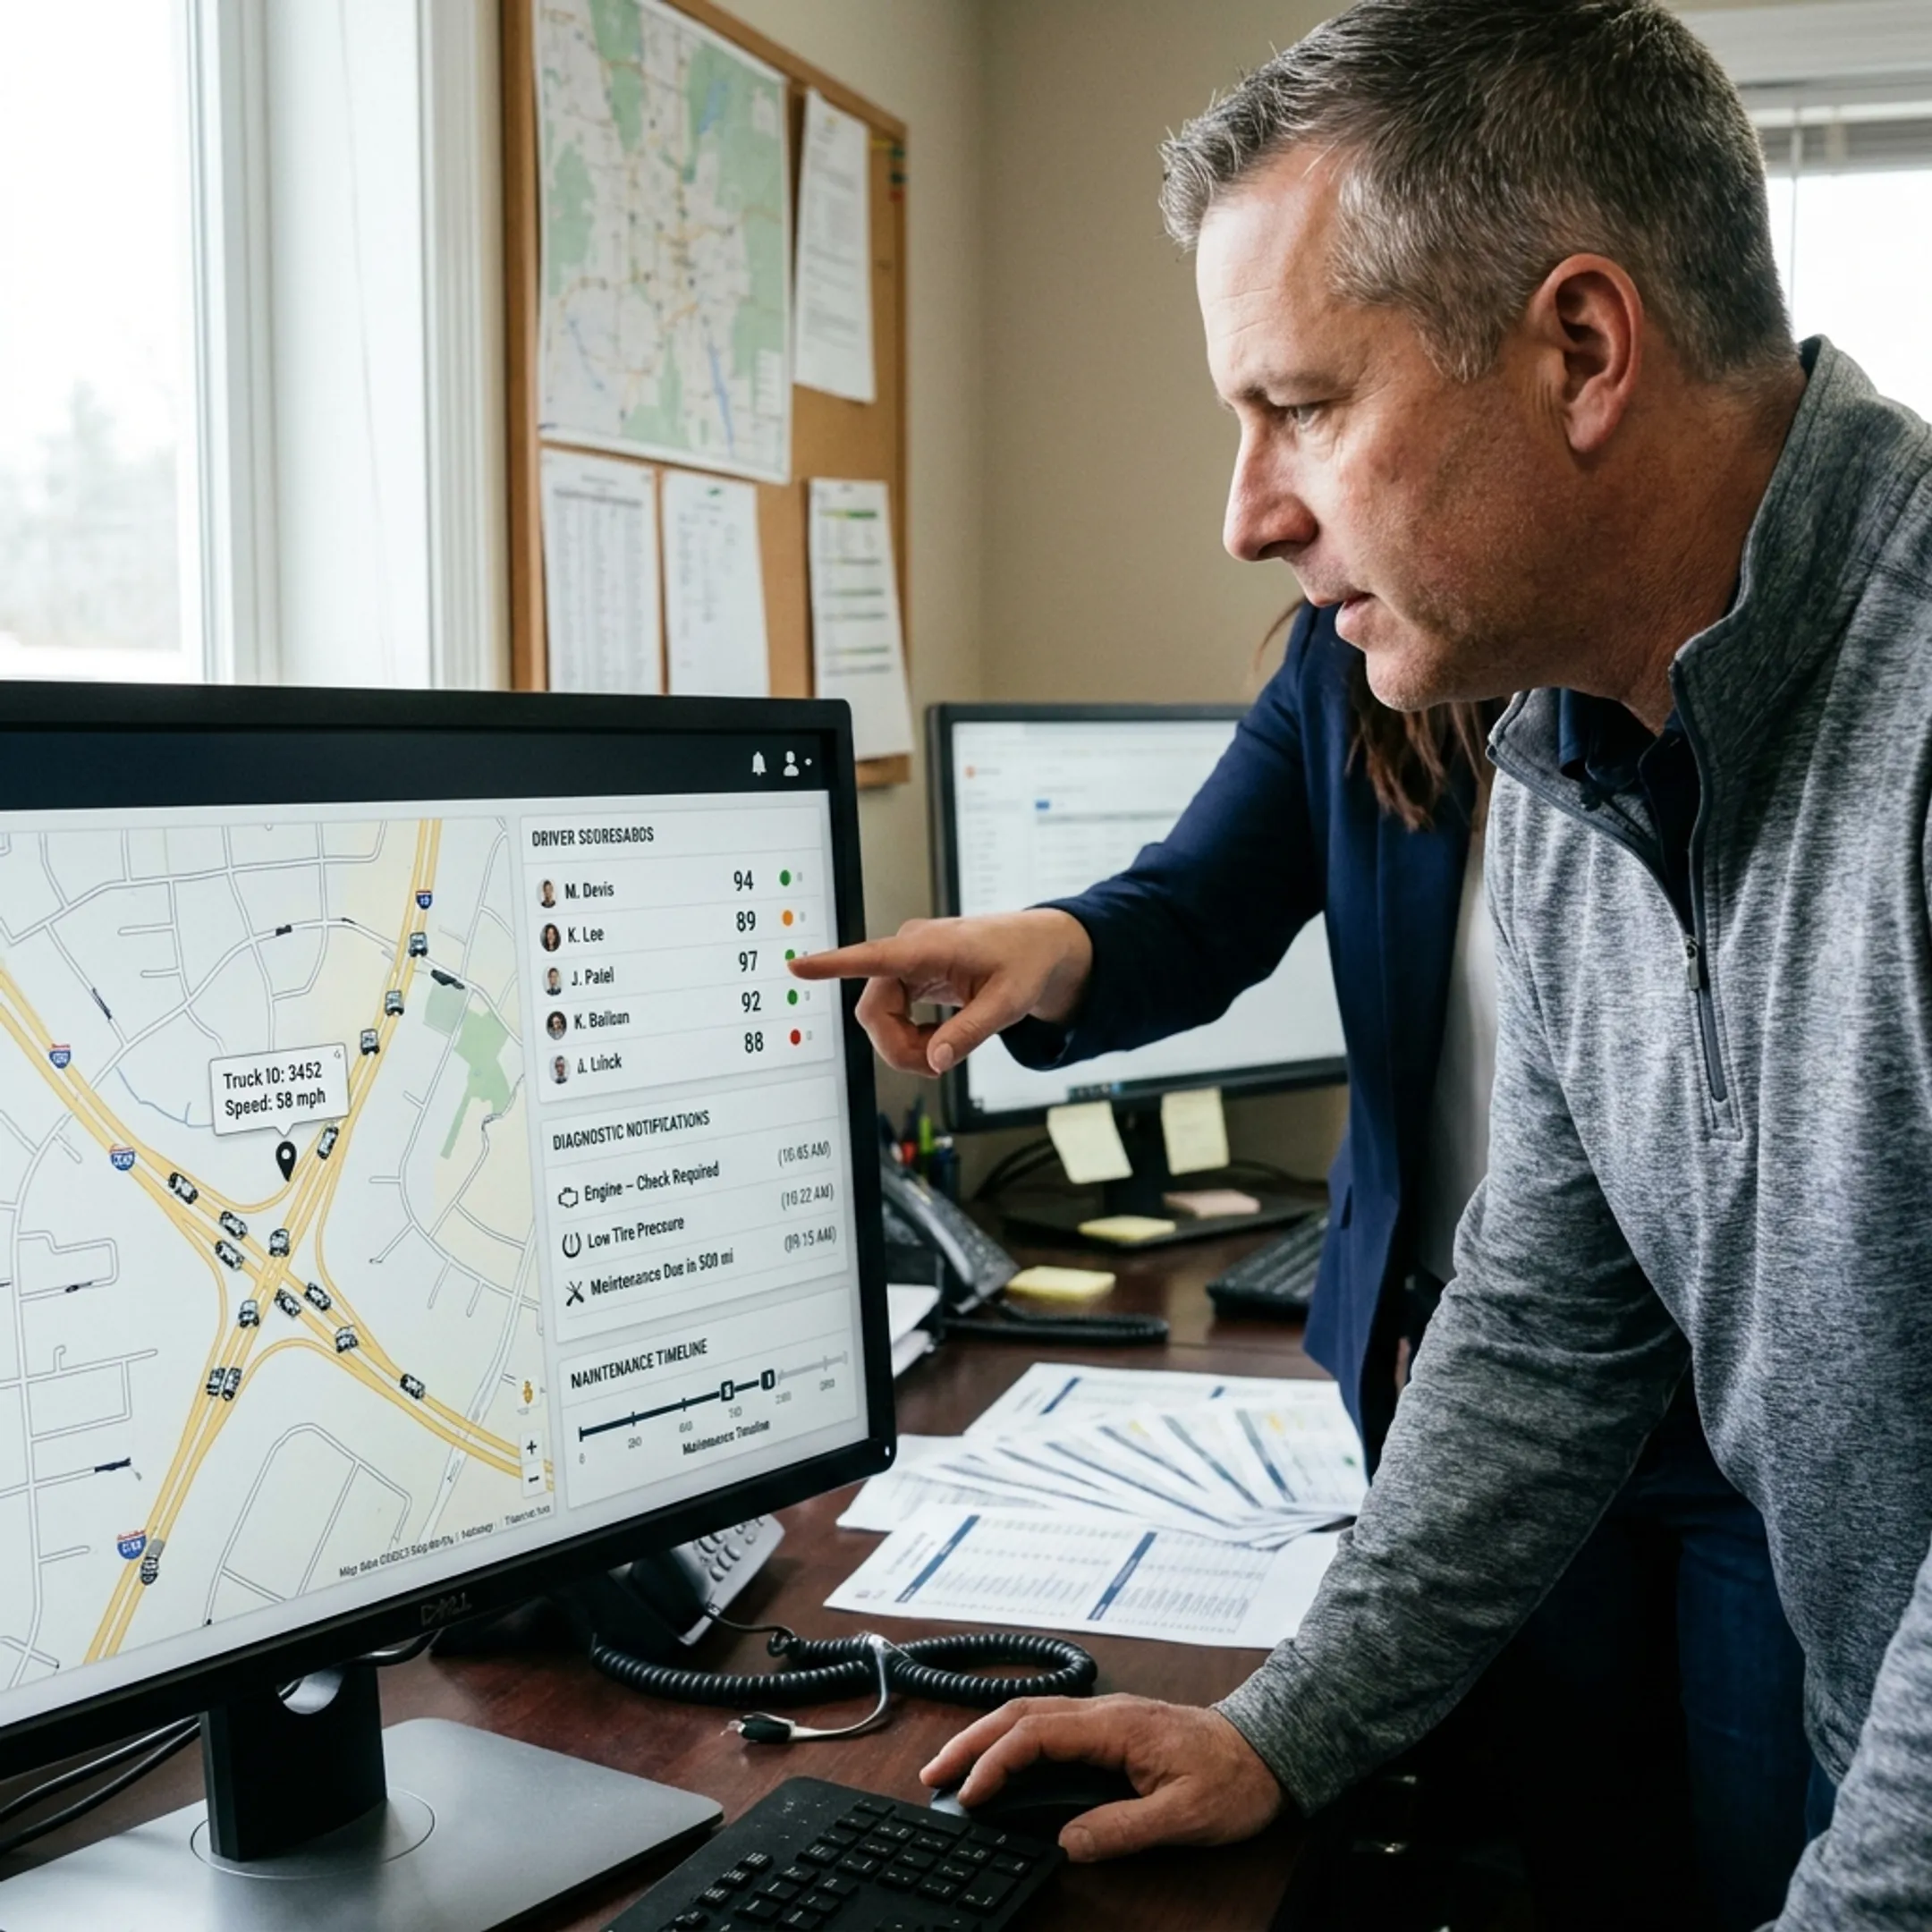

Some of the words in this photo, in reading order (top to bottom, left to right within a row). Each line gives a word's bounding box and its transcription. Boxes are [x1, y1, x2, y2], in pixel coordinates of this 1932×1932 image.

[733, 870, 754, 891] 94
[736, 911, 756, 932] 89
[567, 927, 580, 943] K.
[583, 927, 605, 943] Lee
[739, 950, 758, 972] 97
[741, 990, 762, 1013] 92
[573, 1013, 587, 1030] K.
[744, 1030, 764, 1054] 88
[223, 1068, 263, 1089] Truck
[288, 1061, 322, 1082] 3452
[225, 1094, 273, 1119] Speed:
[275, 1091, 293, 1109] 58
[296, 1088, 326, 1109] mph
[553, 1124, 623, 1150] DIAGNOSTIC
[584, 1182, 623, 1203] Engine
[636, 1170, 670, 1191] Check
